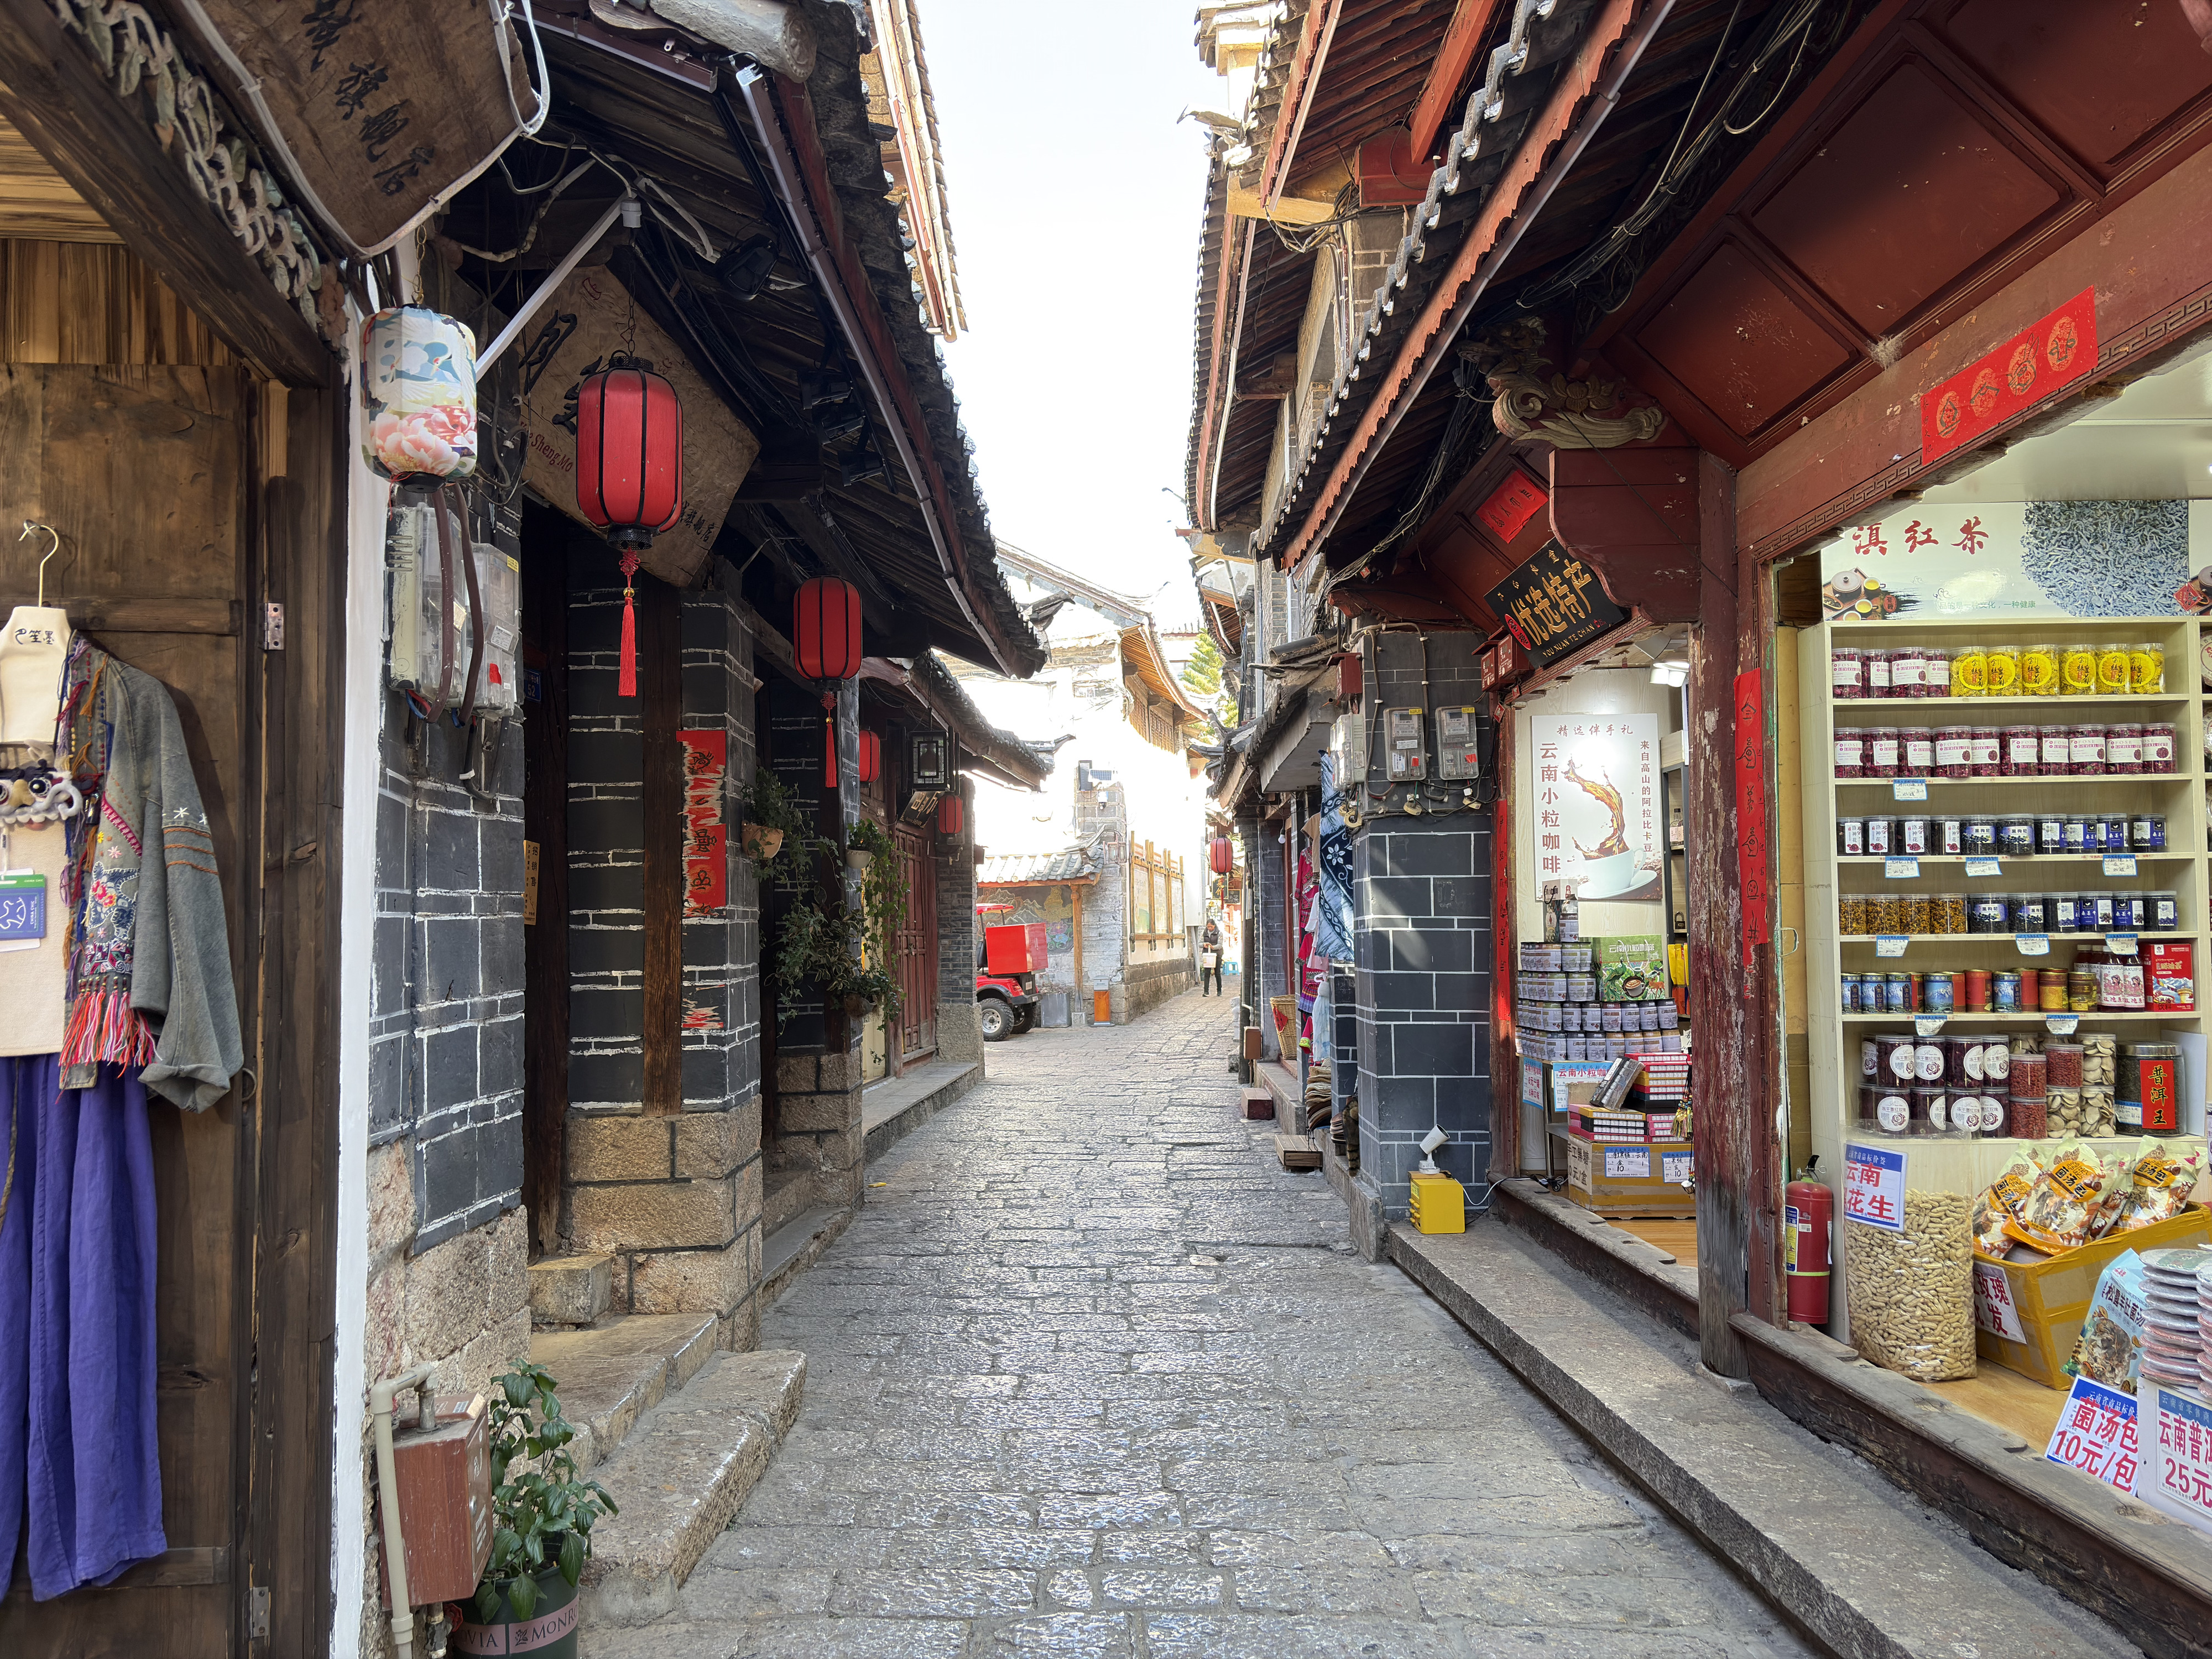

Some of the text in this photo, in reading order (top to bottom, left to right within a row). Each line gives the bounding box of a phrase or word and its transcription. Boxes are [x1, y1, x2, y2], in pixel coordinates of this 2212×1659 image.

[531, 434, 573, 472] Sheng Mo
[1853, 515, 1990, 555] 滇红茶
[1511, 559, 1592, 646] 优选特产
[1542, 648, 1554, 658] YOU
[1553, 638, 1569, 653] XUAN
[1578, 625, 1595, 638] CHAN
[1557, 724, 1634, 737] 精选伴手礼
[1540, 742, 1561, 874] 云南小粒咖啡
[1640, 740, 1653, 852] 来自高山的阿拉比卡豆
[2148, 1065, 2168, 1125] 普洱王
[1567, 1143, 1589, 1165] 手工黑糖
[1846, 1160, 1883, 1187] 云南
[2072, 1397, 2138, 1453] 菌汤包
[2089, 1391, 2137, 1418] 云南省商品标价
[2056, 1430, 2137, 1493] 10元/包
[2166, 1458, 2212, 1508] 25元
